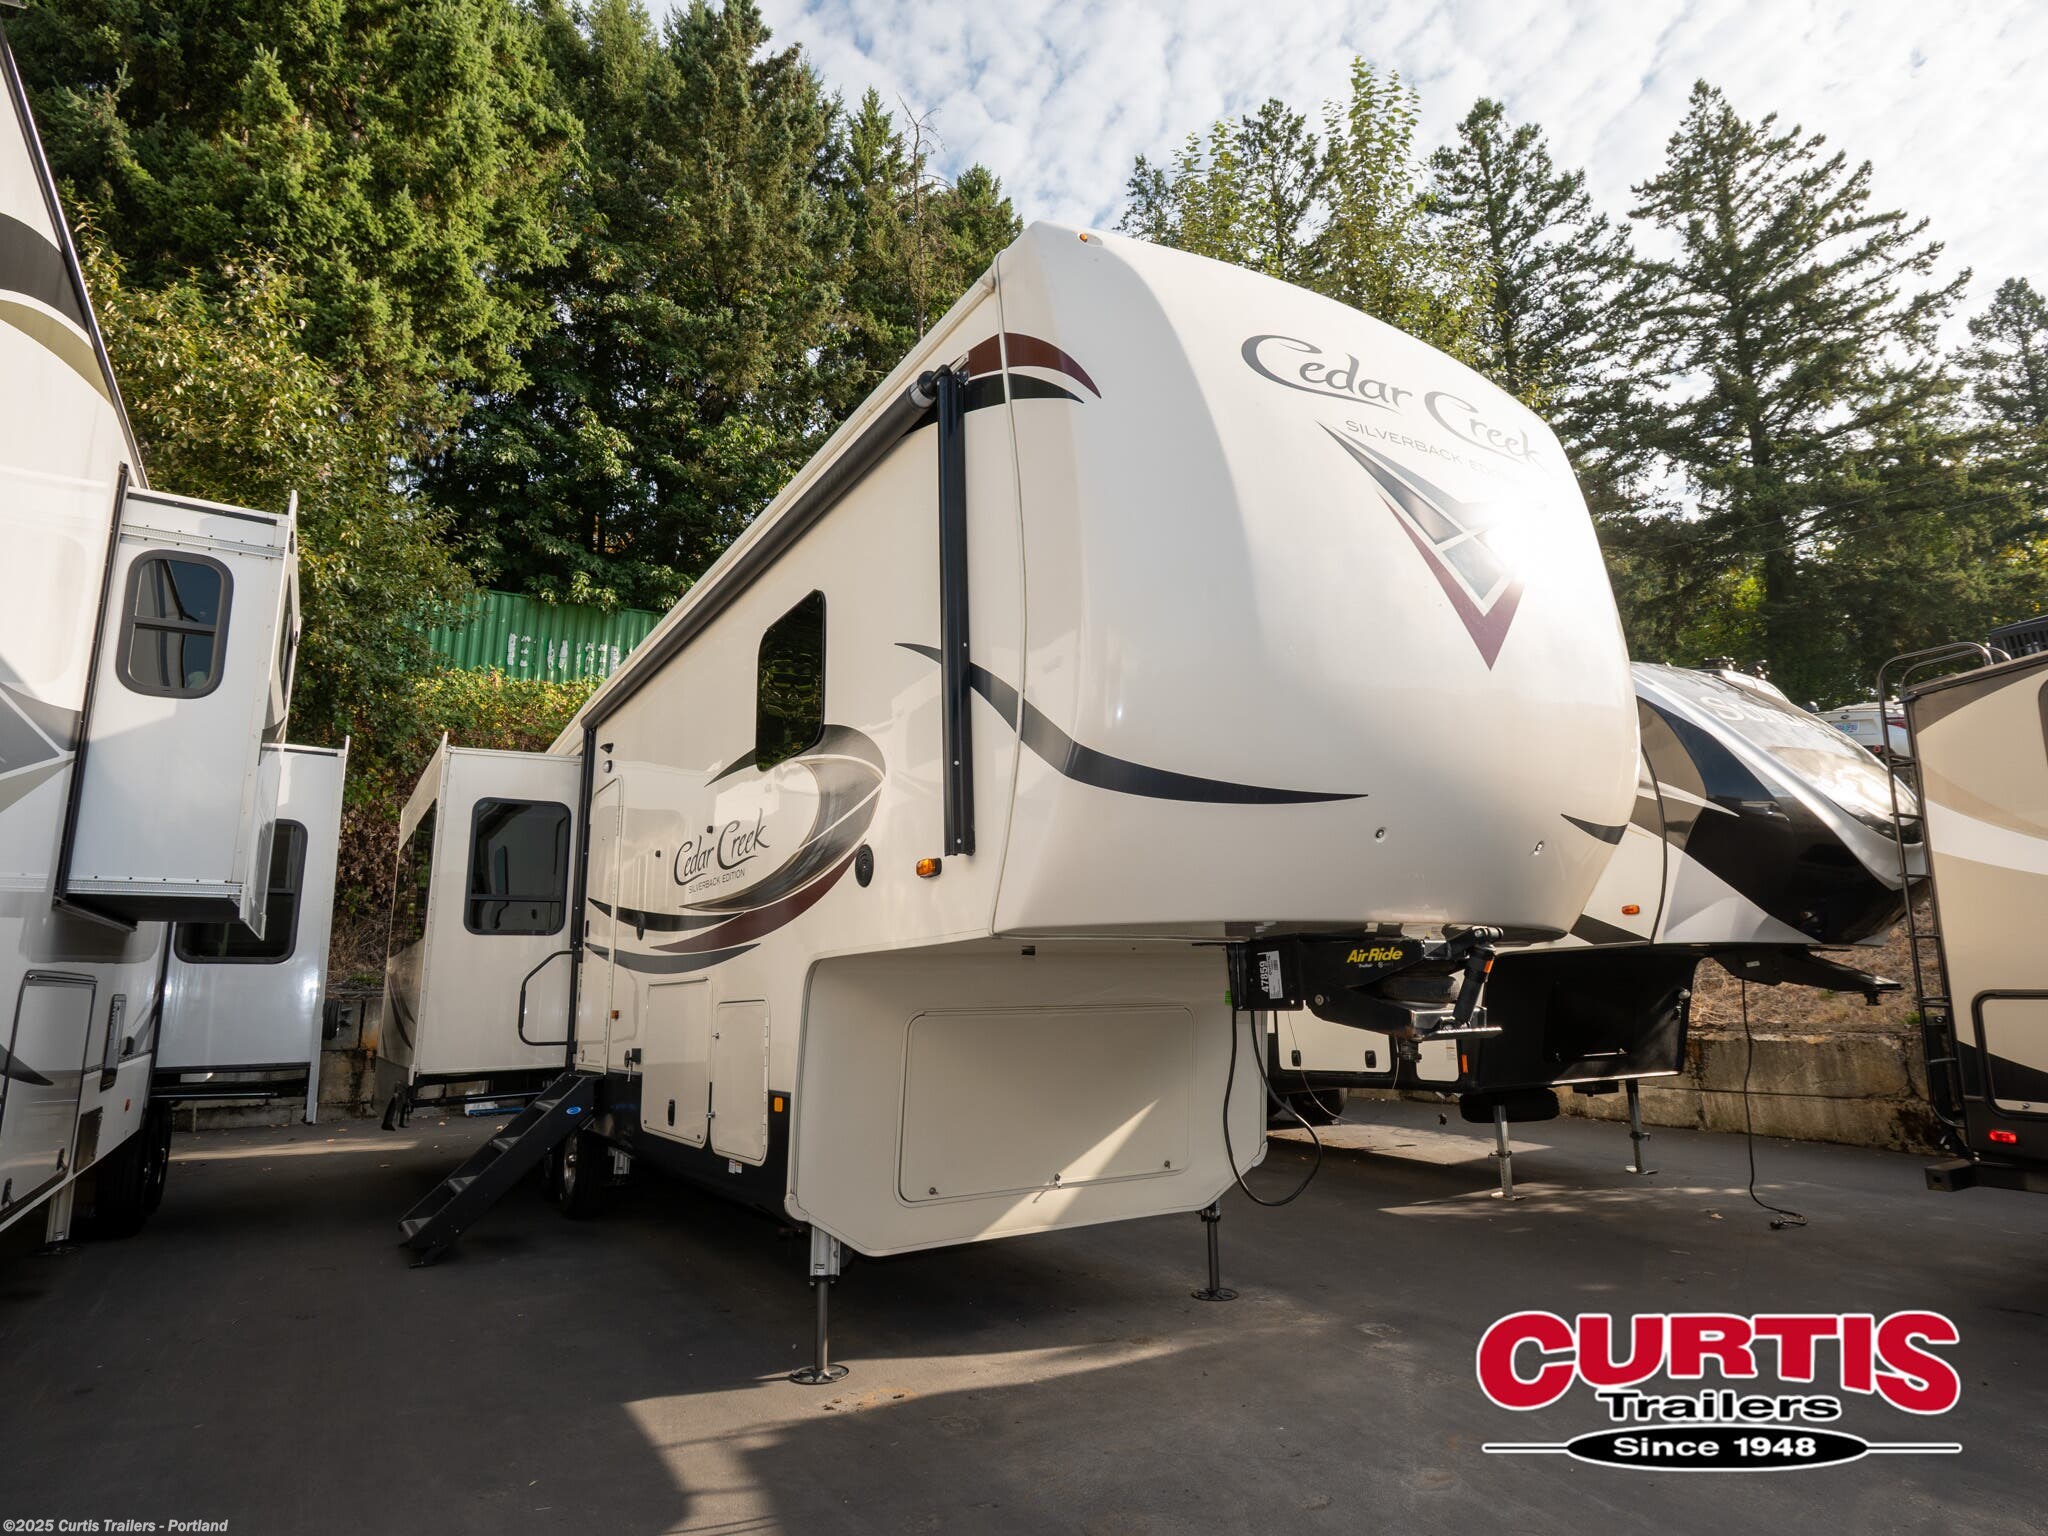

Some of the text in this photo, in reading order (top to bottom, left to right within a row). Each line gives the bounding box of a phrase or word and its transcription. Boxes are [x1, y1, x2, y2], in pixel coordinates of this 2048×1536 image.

[1241, 335, 1549, 473] Cedar Creek
[1345, 420, 1462, 464] SILVERBACK
[674, 808, 770, 886] Cedar Creek
[688, 868, 745, 894] SILVERBACK EDITION
[1260, 960, 1269, 993] 47859
